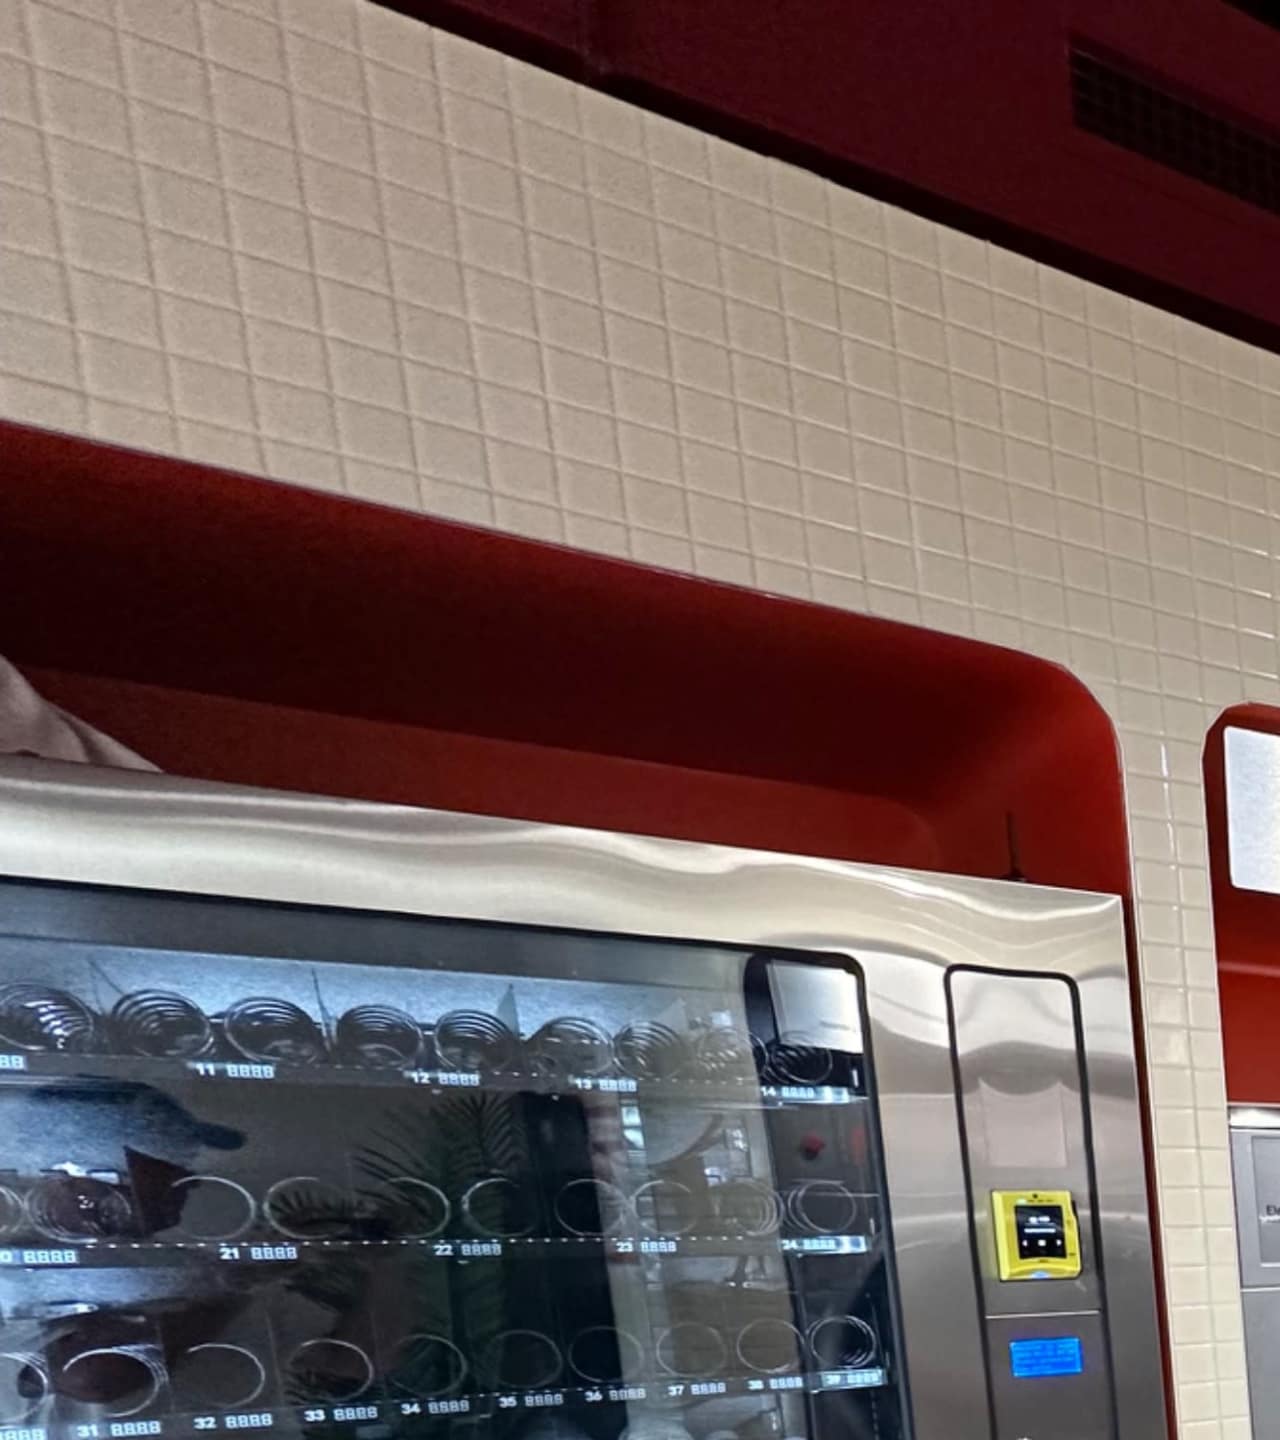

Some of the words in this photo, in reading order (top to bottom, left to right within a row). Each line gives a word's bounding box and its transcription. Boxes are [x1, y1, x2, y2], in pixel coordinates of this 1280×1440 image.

[196, 1064, 215, 1076] 11
[412, 1072, 431, 1084] 12
[433, 1245, 453, 1256] 22
[616, 1242, 633, 1253] 23
[220, 1249, 240, 1260] 21
[668, 1385, 684, 1396] 37
[499, 1396, 517, 1408] 35
[401, 1403, 421, 1415] 34
[304, 1409, 325, 1422] 33
[194, 1417, 217, 1430] 32
[77, 1425, 98, 1437] 31
